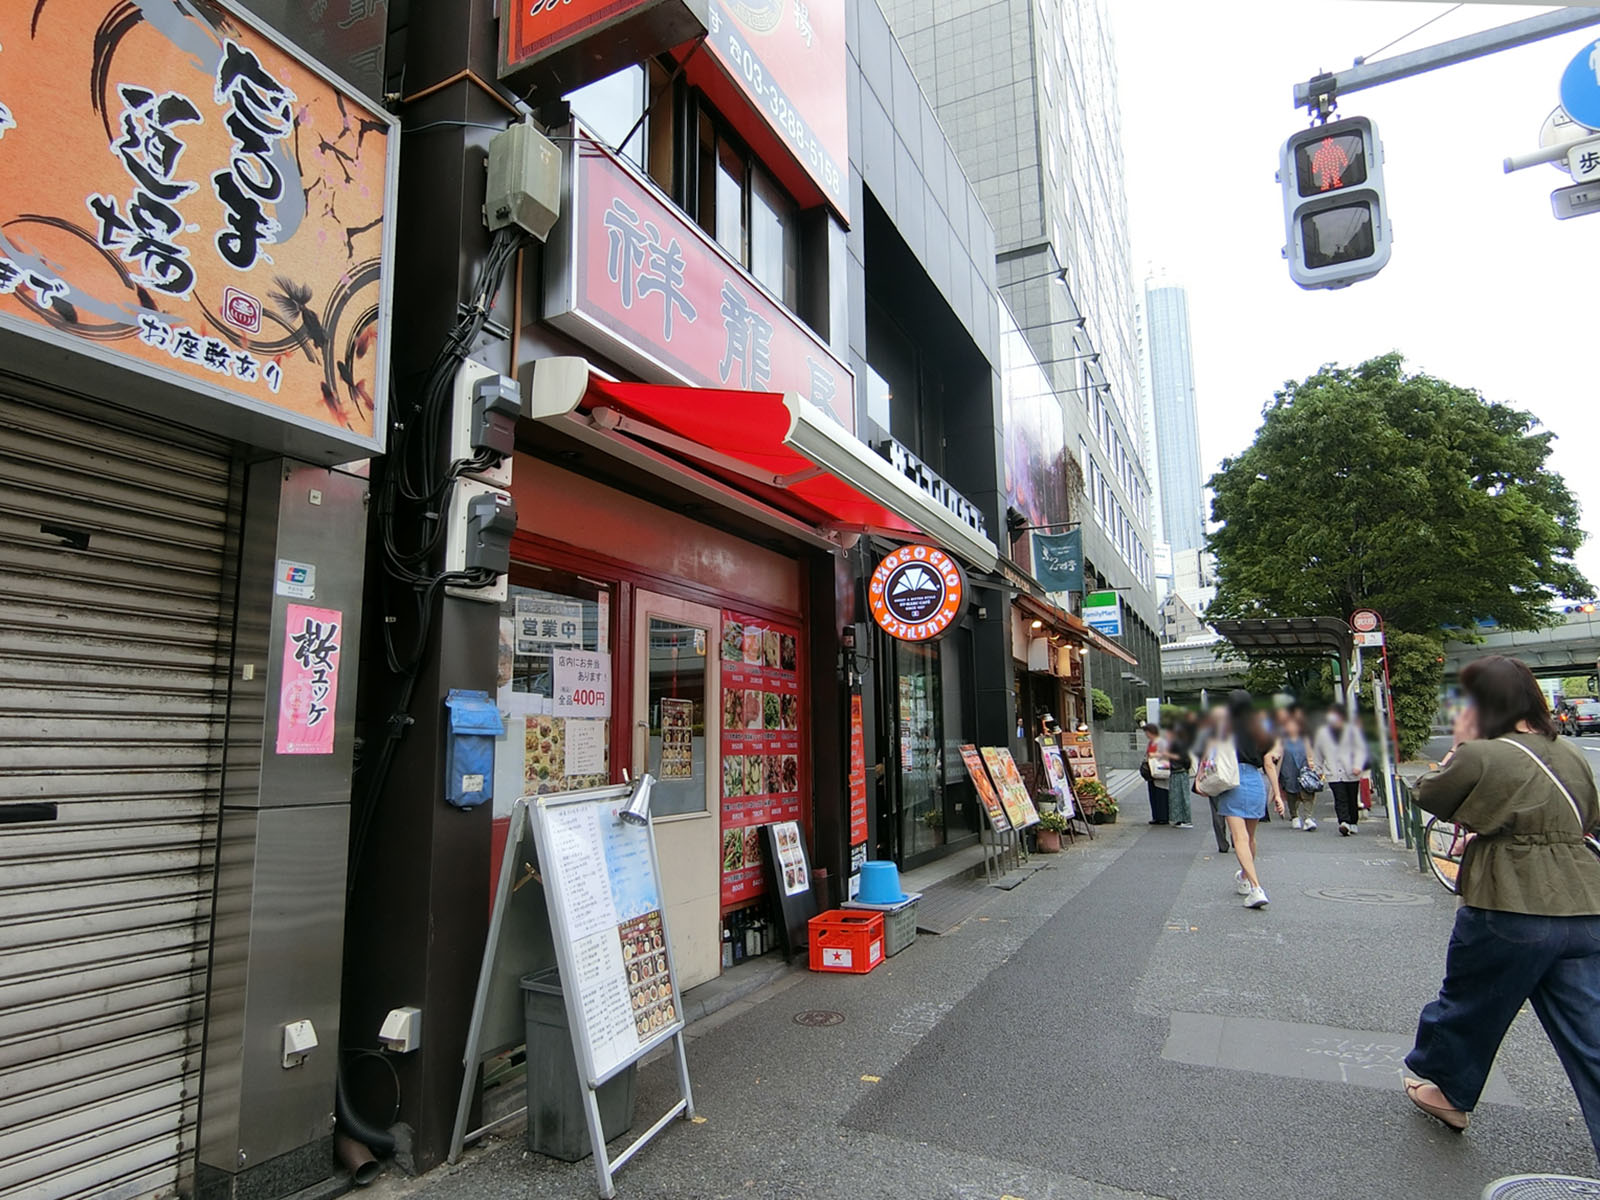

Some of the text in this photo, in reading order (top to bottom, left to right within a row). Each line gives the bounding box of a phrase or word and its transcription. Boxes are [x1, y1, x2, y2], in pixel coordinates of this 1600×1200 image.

[742, 49, 840, 196] 03-3288-5158
[213, 38, 293, 269] だるま
[141, 317, 281, 390] お座敷あり
[871, 546, 927, 594] CHOCO
[930, 551, 959, 588] CRO
[522, 617, 577, 639] 営業中
[881, 608, 955, 639] サンマルクカフェ
[290, 616, 340, 728] 桜ユッケ
[558, 656, 600, 669] 店内にお弁当
